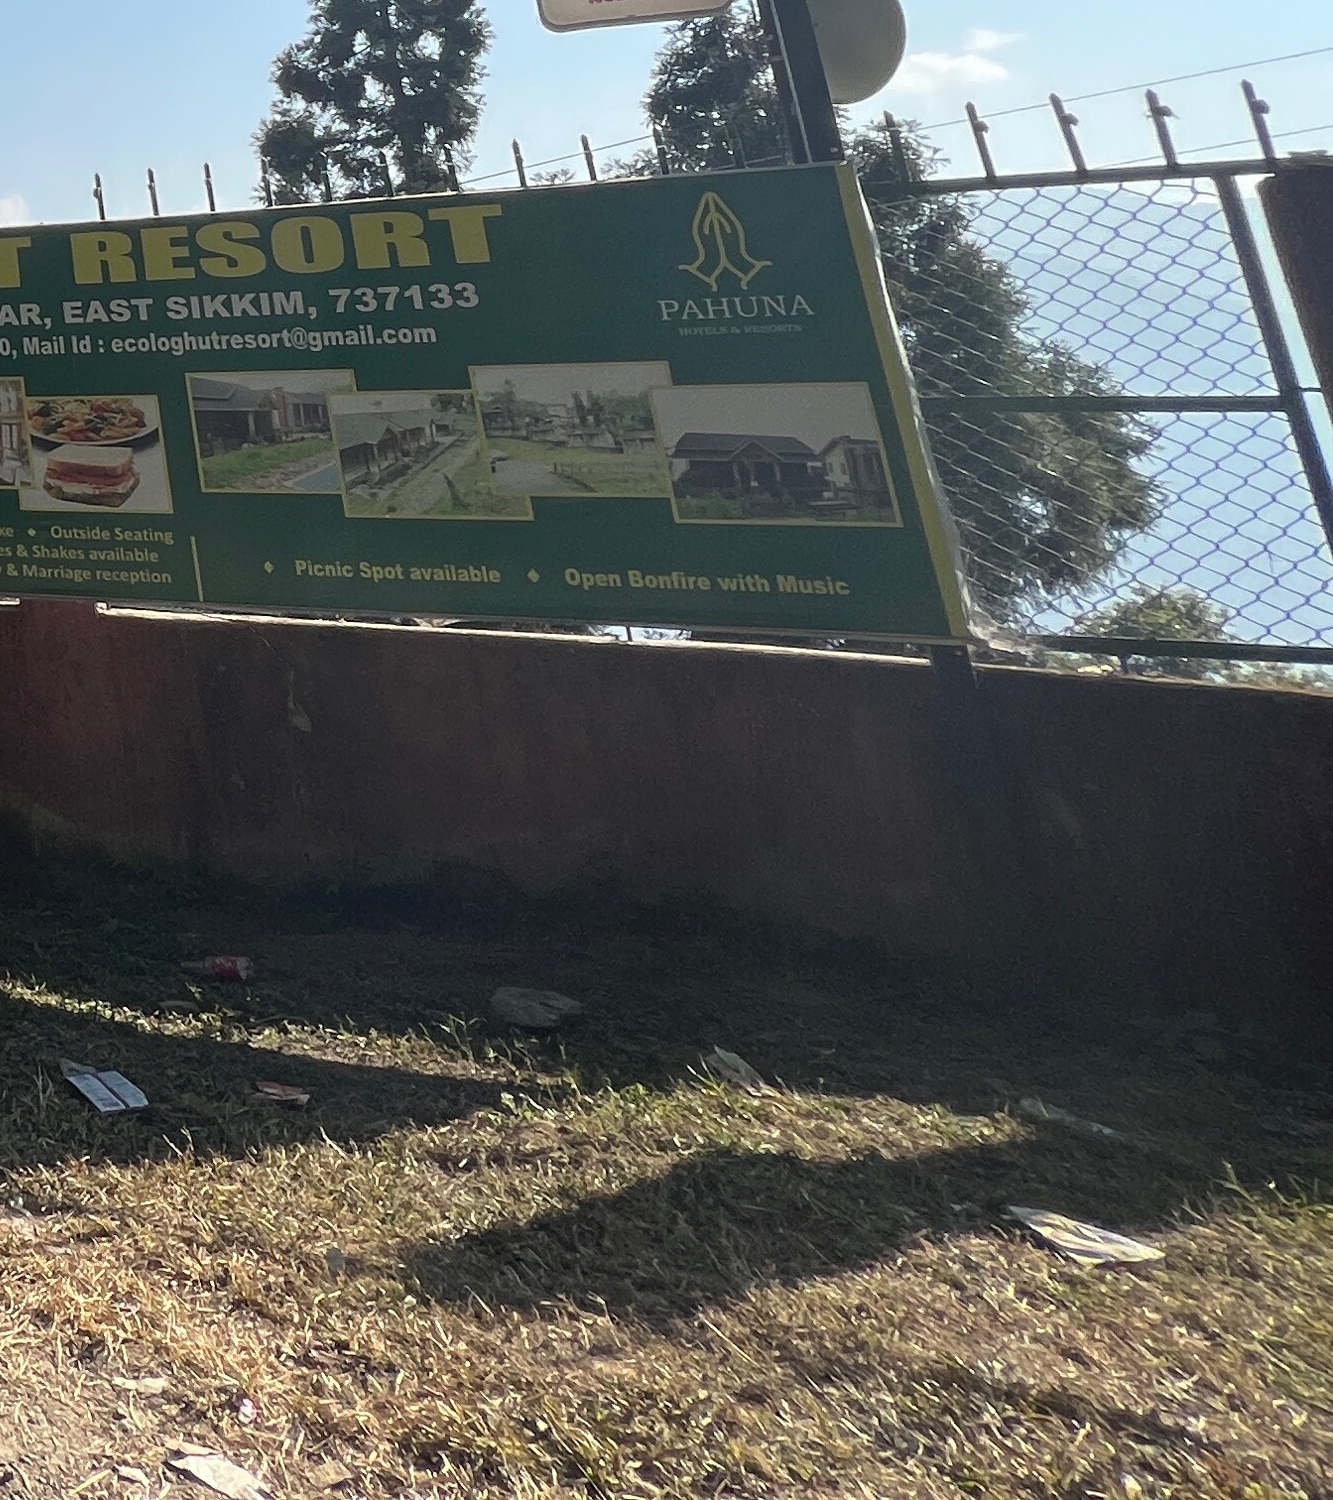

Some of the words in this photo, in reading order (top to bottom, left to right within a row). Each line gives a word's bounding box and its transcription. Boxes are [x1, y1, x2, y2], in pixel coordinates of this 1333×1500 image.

[70, 203, 503, 284] RESORT
[62, 298, 153, 324] EAST
[166, 290, 318, 320] SIKKIM,
[328, 282, 480, 314] 737133
[656, 294, 815, 321] PAHUNA
[22, 335, 65, 355] Mail
[72, 334, 91, 353] Id
[111, 323, 438, 356] ecologhutresort@gmail.com
[50, 525, 111, 541] Outside
[114, 527, 174, 545] Seating
[16, 544, 28, 557] &
[32, 544, 85, 559] Shakes
[89, 546, 159, 562] available
[6, 563, 18, 577] &
[22, 564, 92, 582] Marriage
[96, 569, 172, 585] reception
[294, 559, 354, 578] Picnic
[359, 561, 404, 582] Spot
[409, 563, 501, 583] available
[564, 568, 622, 591] Open
[627, 569, 711, 591] Bonfire
[718, 573, 770, 593] with
[776, 574, 851, 596] Music
